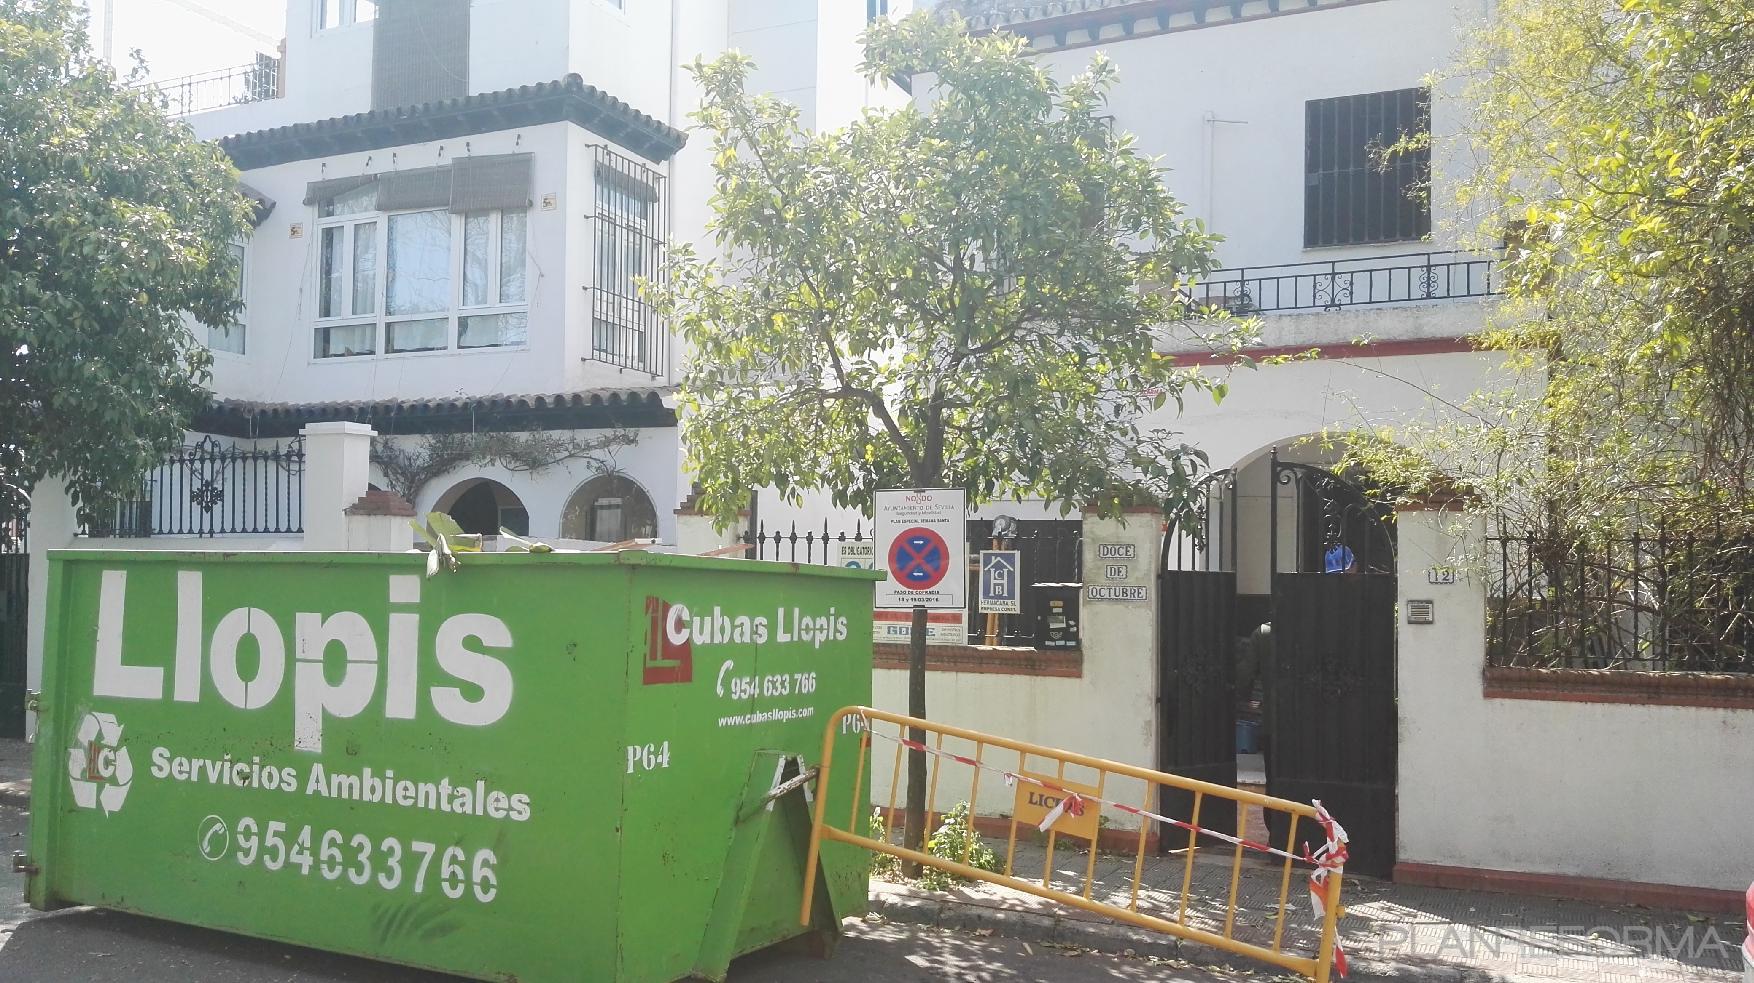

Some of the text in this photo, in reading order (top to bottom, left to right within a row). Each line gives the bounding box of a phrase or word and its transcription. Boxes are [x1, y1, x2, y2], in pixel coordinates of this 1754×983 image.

[1102, 545, 1132, 557] DOCE
[1109, 566, 1124, 577] DE
[1433, 568, 1451, 582] 12
[1090, 586, 1144, 599] OCTUBRE
[666, 603, 848, 649] Cubas Llopis
[93, 570, 514, 752] Llopis
[731, 671, 817, 700] 954 633 766
[718, 706, 814, 727] www.cubasllopis.com
[626, 741, 671, 774] P64
[151, 746, 531, 821] Servicios Ambientales
[236, 816, 498, 902] 954633766
